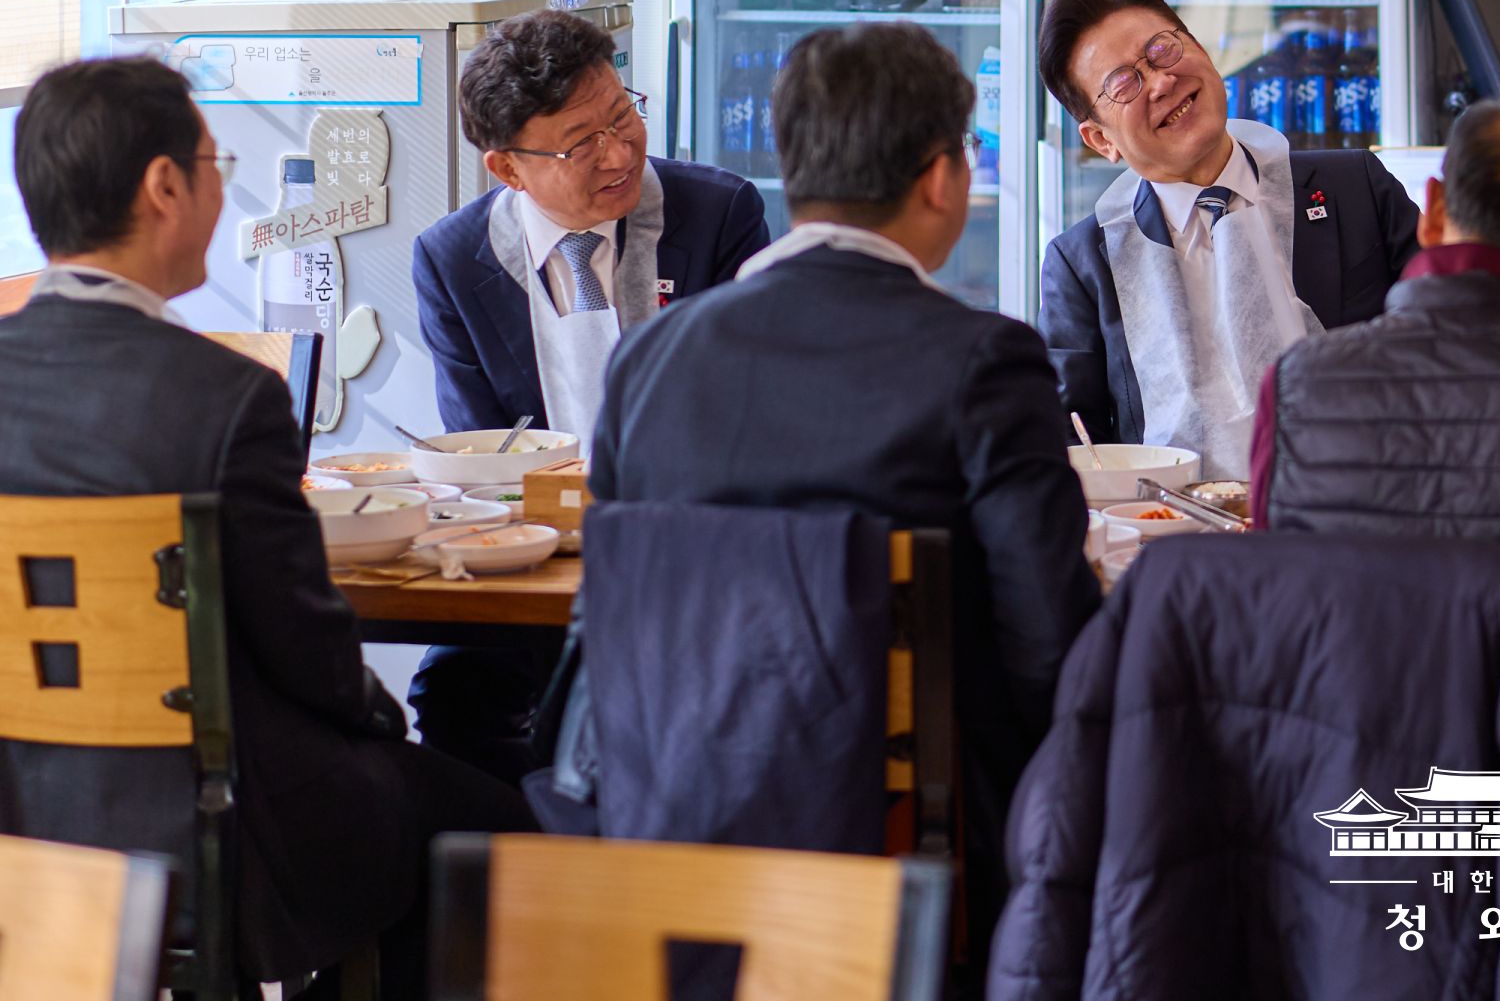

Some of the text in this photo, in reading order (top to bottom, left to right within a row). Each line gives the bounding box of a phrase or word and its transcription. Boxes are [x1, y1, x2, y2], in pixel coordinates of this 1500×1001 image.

[245, 46, 312, 62] 우리 업소는
[309, 67, 321, 83] 을
[252, 194, 375, 251] 無아스파탐
[304, 252, 314, 302] 쌀막걸리
